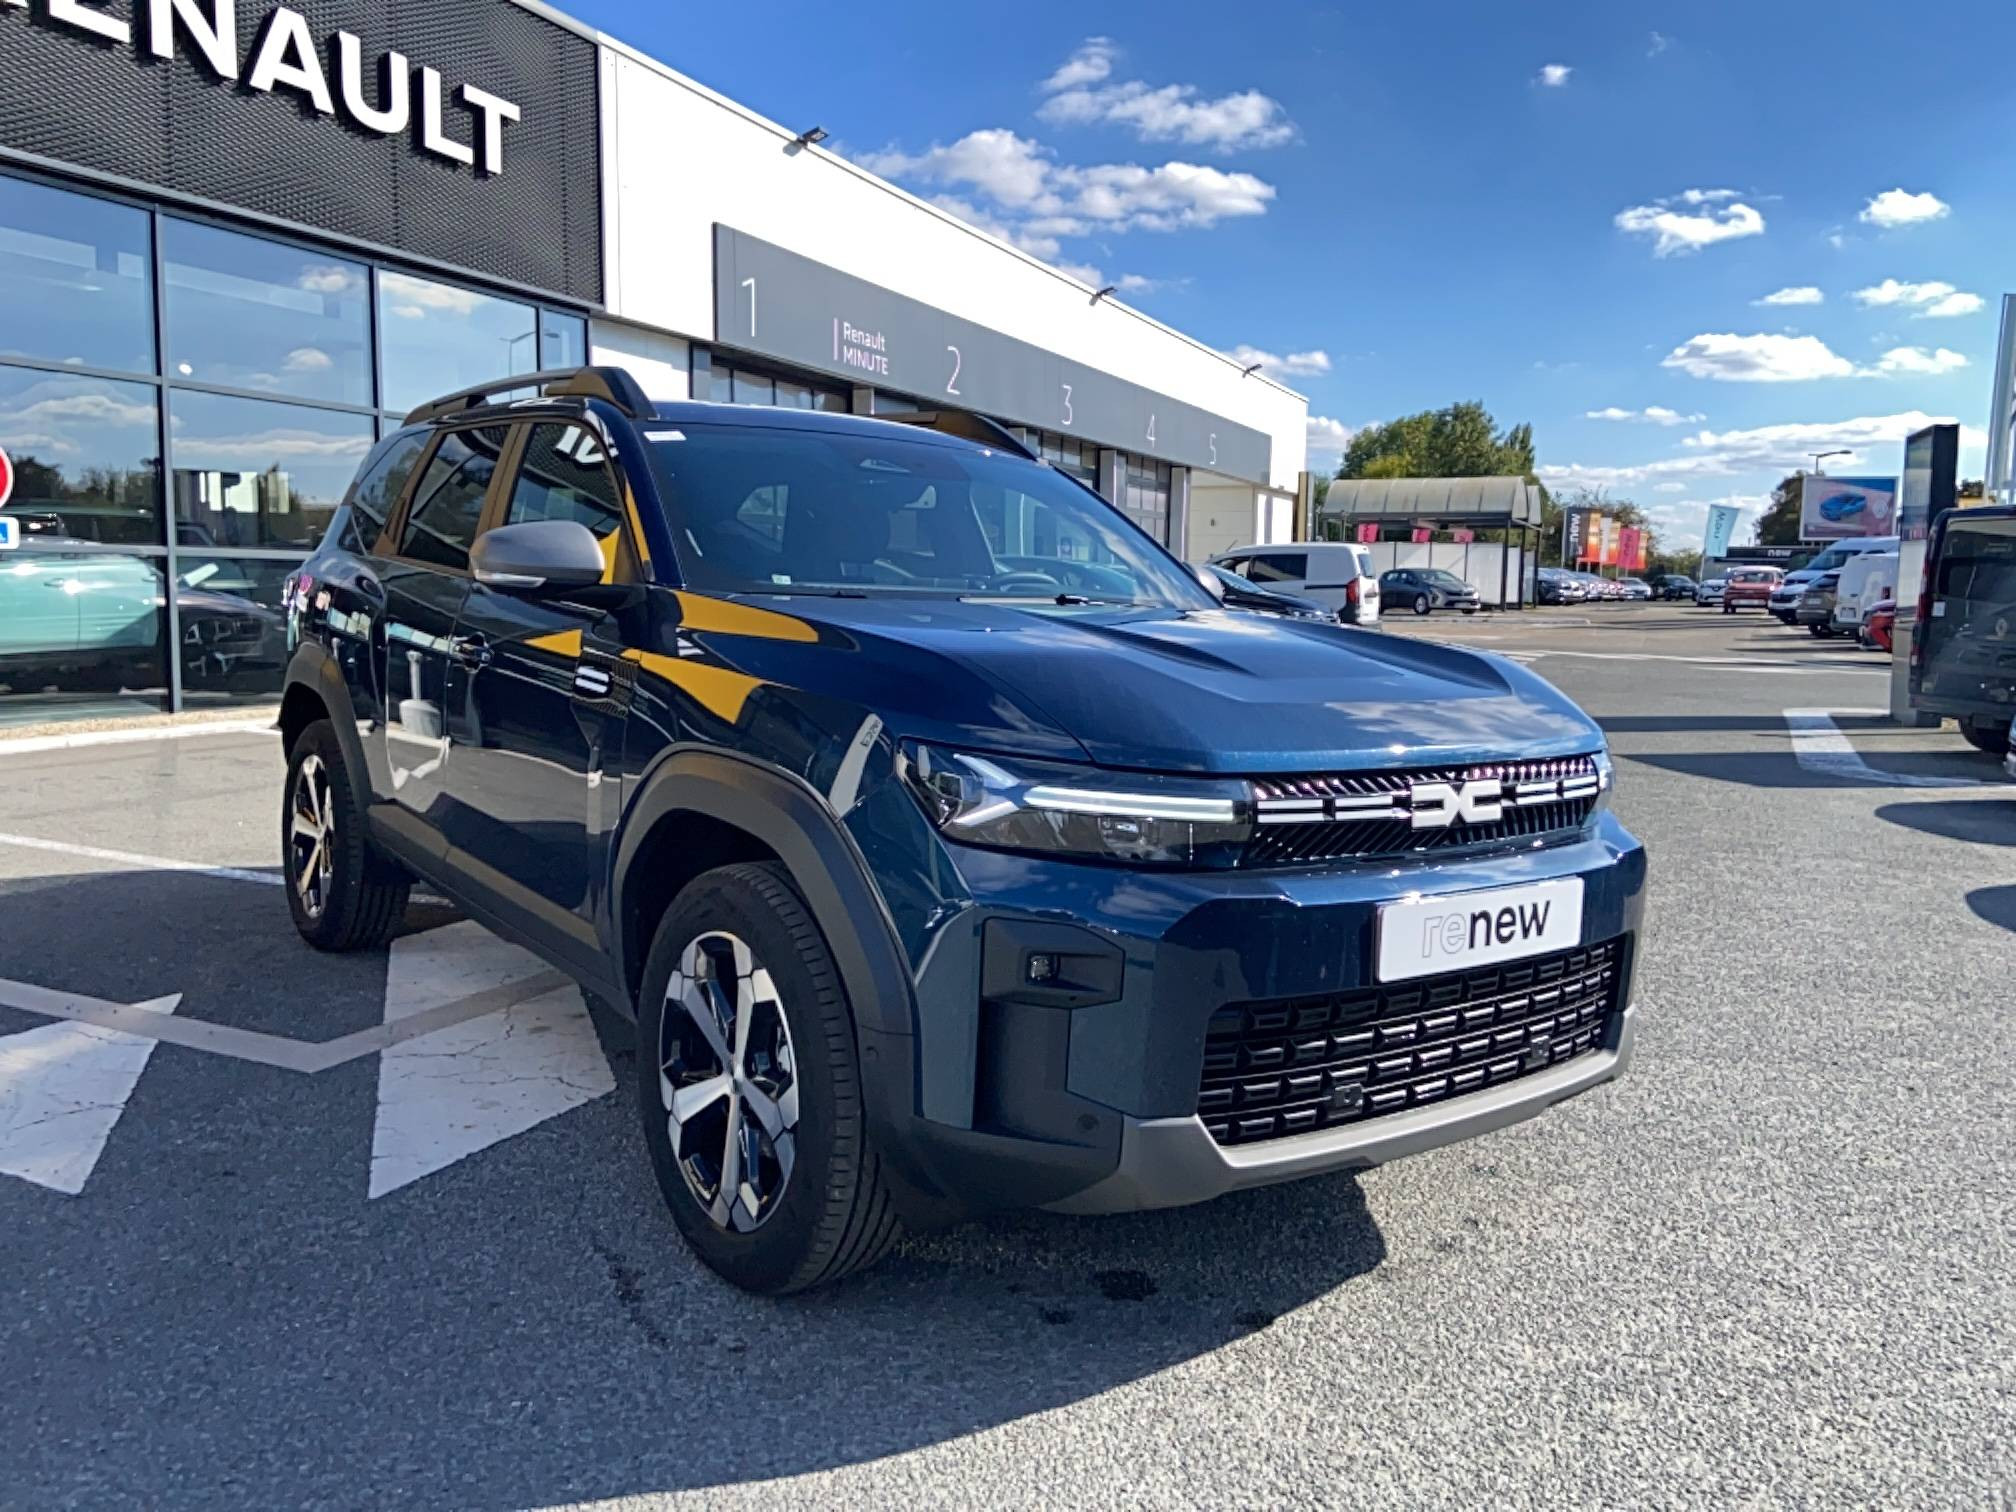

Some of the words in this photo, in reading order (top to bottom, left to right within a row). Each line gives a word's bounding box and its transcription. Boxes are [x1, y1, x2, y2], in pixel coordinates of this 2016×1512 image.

[0, 0, 520, 174] NAULT
[742, 277, 755, 337] 1
[842, 321, 886, 352] Renault
[842, 345, 889, 376] MINUTE
[946, 345, 961, 395] 2
[1061, 384, 1073, 425] 3
[1146, 413, 1156, 449] 4
[1209, 433, 1217, 465] 5
[1422, 900, 1551, 958] renew
